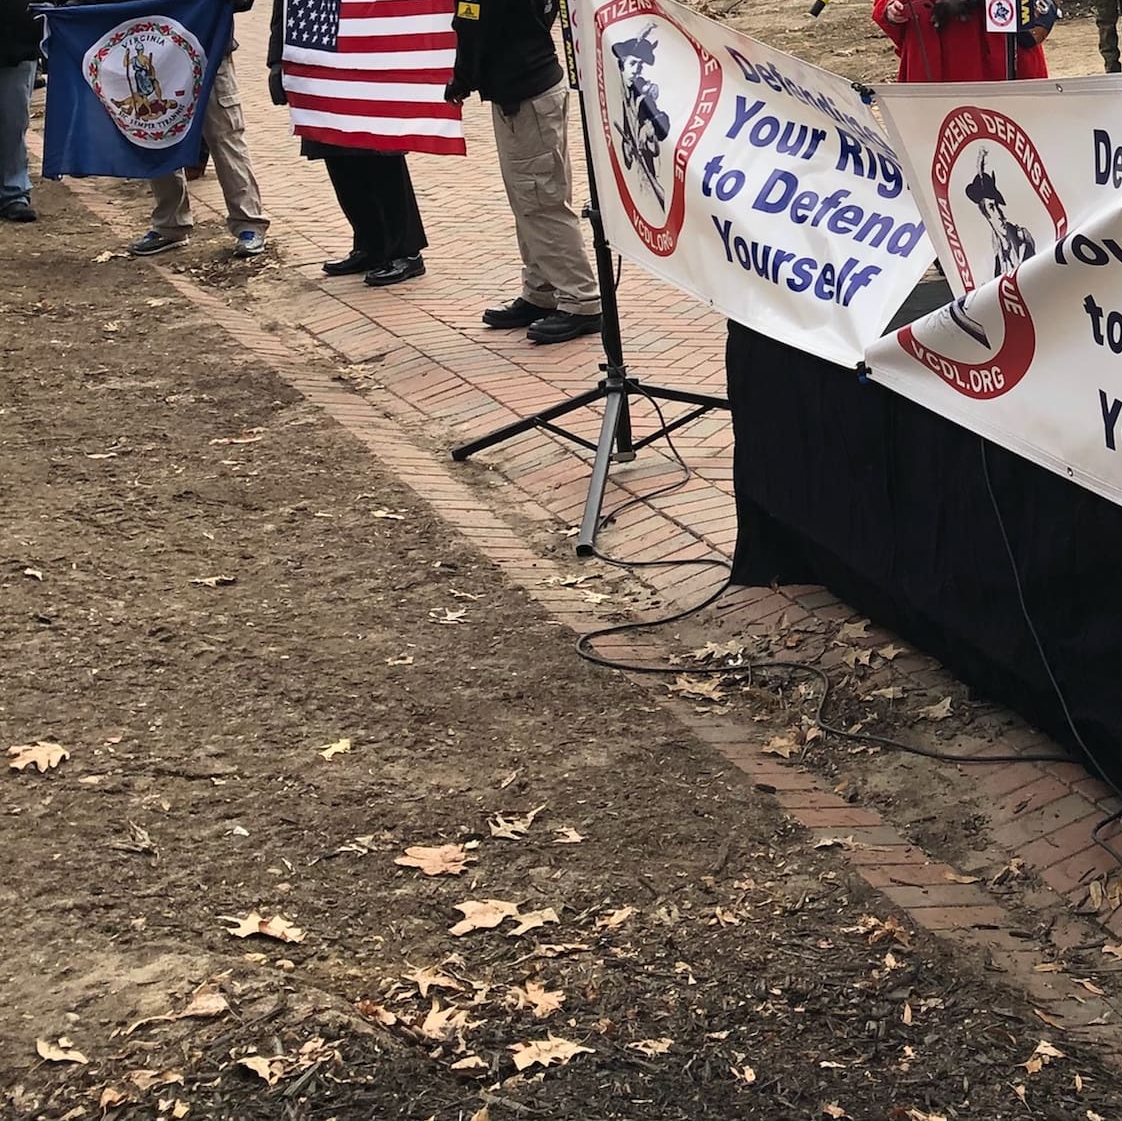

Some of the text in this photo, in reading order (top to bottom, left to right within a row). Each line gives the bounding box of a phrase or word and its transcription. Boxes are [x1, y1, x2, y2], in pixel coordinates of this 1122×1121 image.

[121, 34, 166, 49] VIRGINIA
[674, 86, 719, 183] LEAGUE
[725, 95, 828, 161] Your
[934, 111, 978, 186] CITIZENS
[980, 111, 1053, 205] DEFENSE
[631, 209, 674, 252] VCDL.ORG
[701, 154, 927, 259] to Defend
[937, 198, 974, 290] RGINIA
[711, 214, 883, 308] Yourself
[911, 339, 1005, 394] VCDL.ORG
